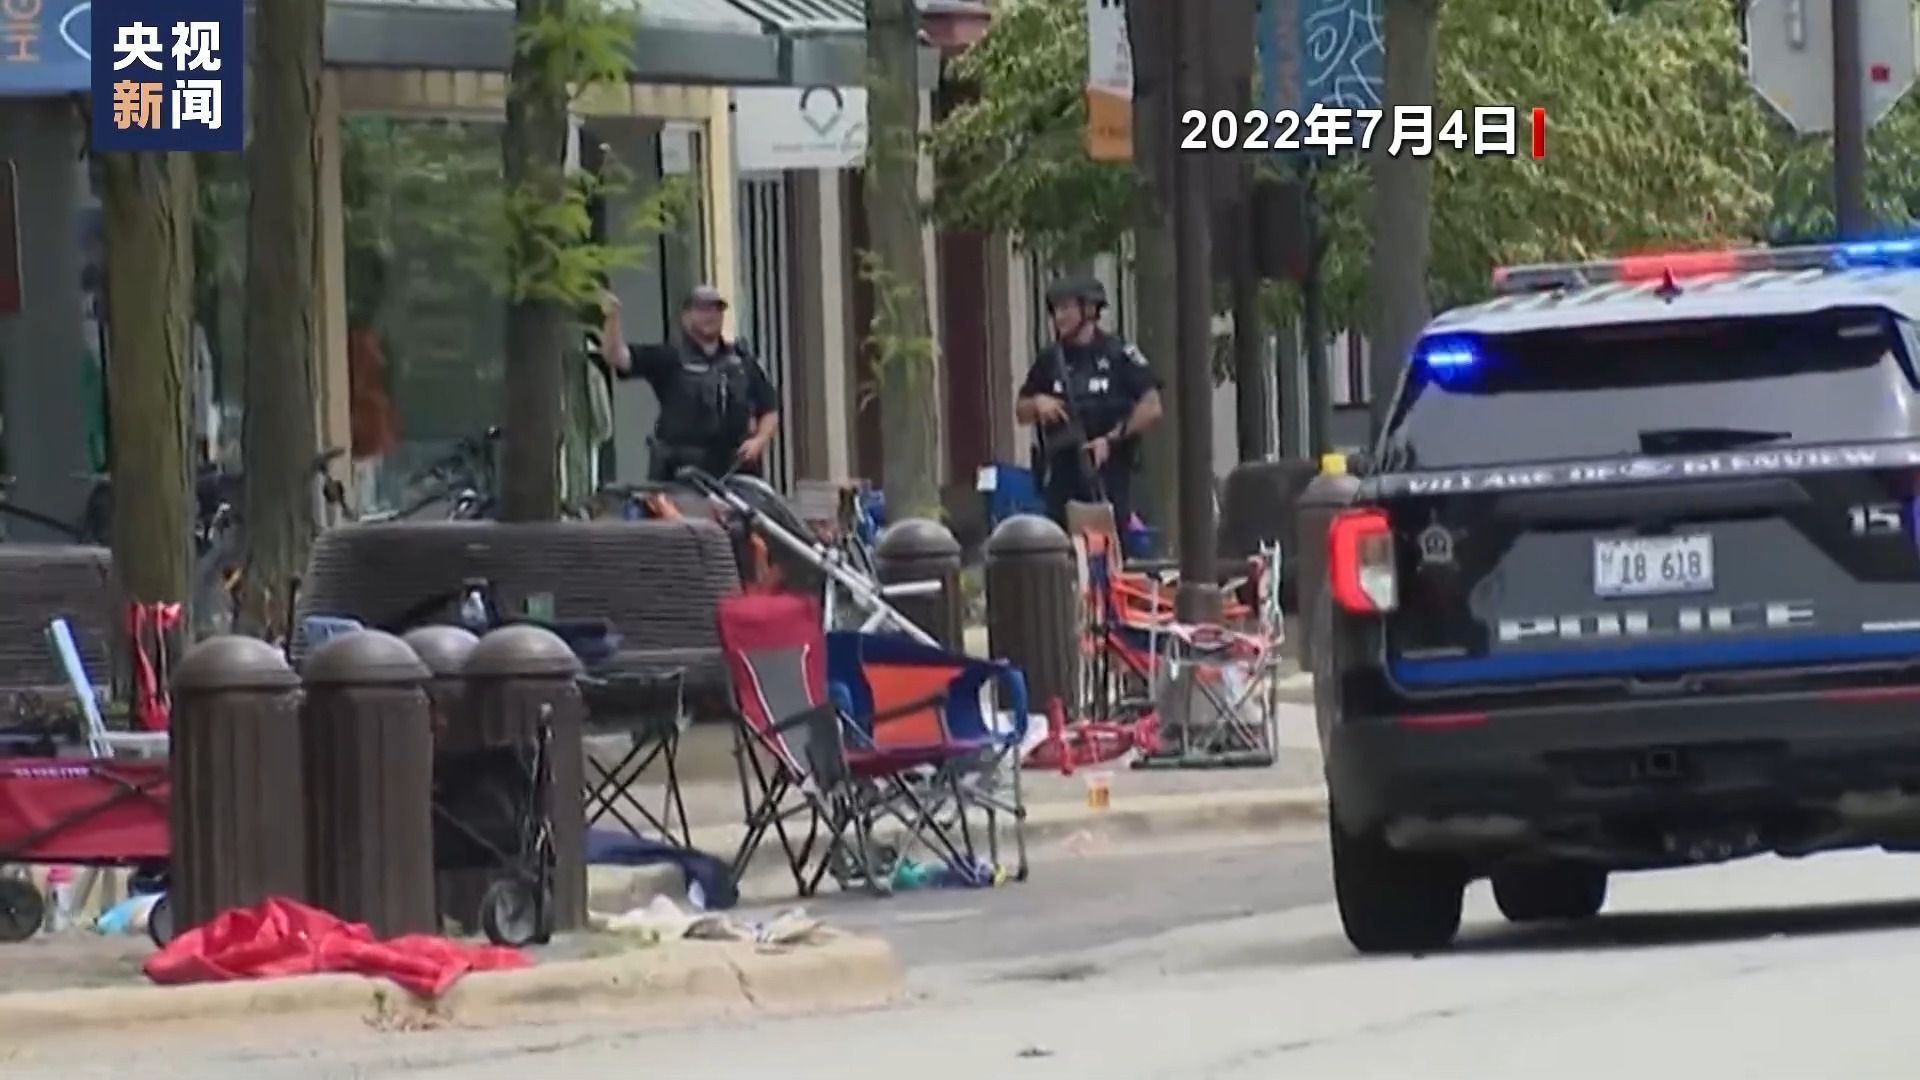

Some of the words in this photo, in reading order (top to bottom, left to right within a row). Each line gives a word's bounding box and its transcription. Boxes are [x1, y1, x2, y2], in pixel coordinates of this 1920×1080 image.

[1848, 505, 1901, 535] 15
[1621, 553, 1646, 584] 18
[1661, 549, 1702, 580] 618
[1499, 600, 1814, 641] POLICE
